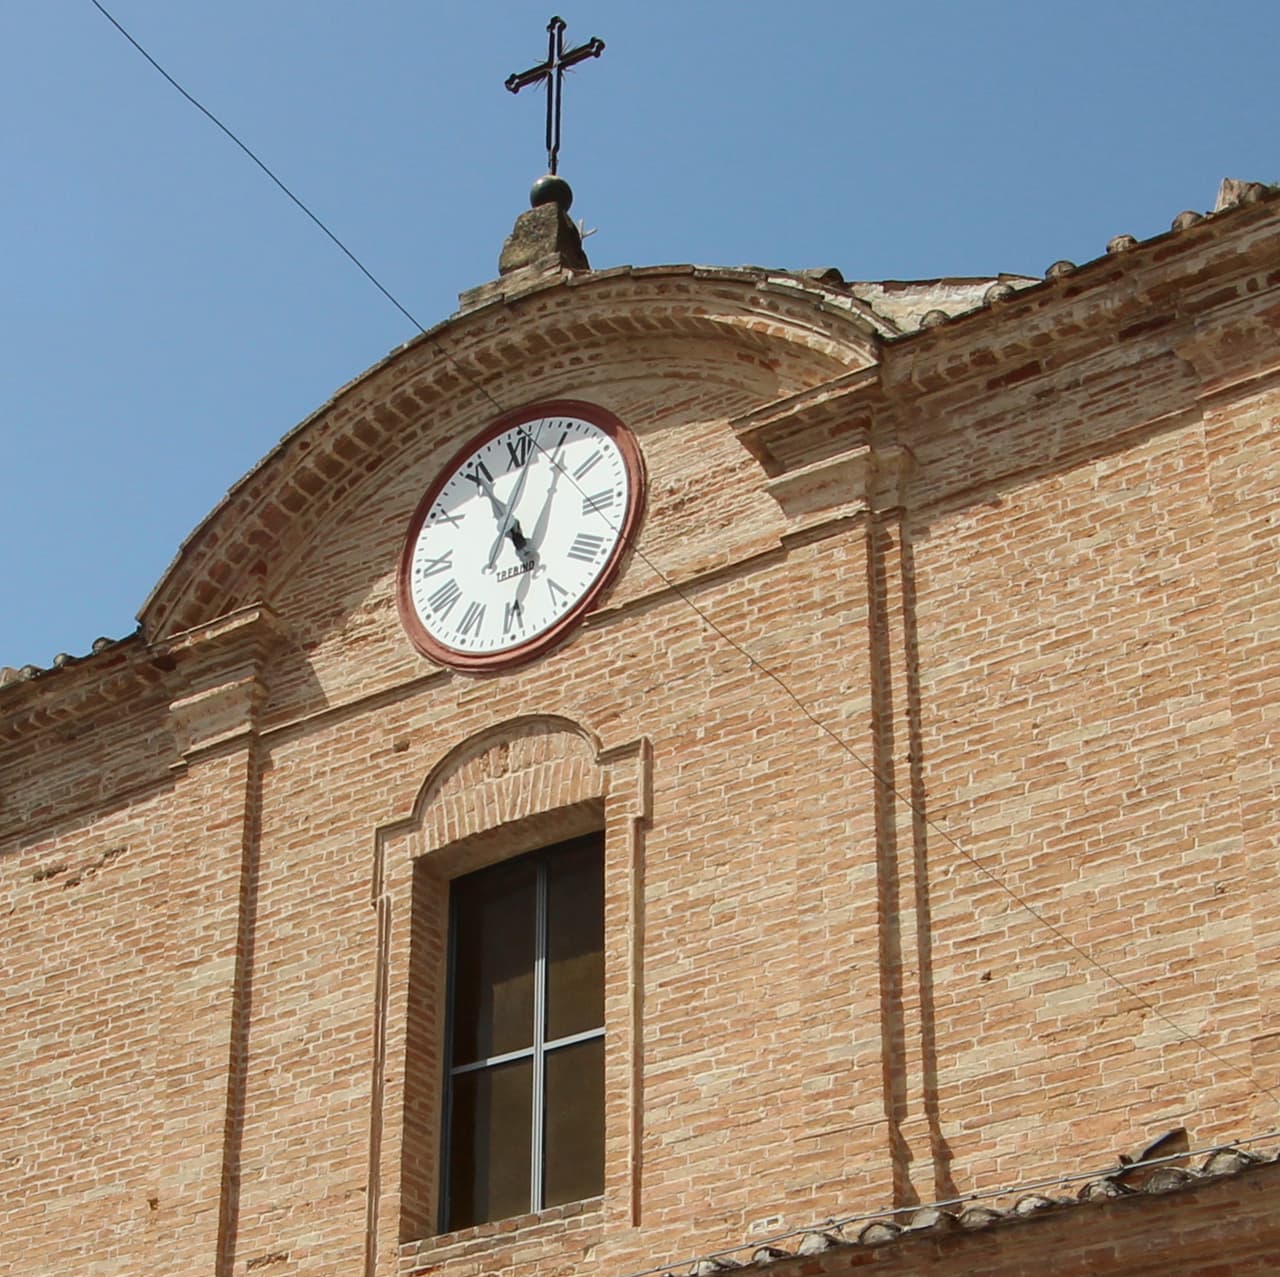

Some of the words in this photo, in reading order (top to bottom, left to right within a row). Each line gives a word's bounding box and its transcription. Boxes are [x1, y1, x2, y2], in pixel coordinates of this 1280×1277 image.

[573, 450, 604, 481] II
[582, 488, 614, 516] III
[436, 509, 465, 529] X
[568, 533, 604, 562] IIII
[424, 549, 454, 579] IX
[496, 561, 535, 582] TREBINO
[427, 579, 462, 622] VIII
[547, 578, 569, 606] V
